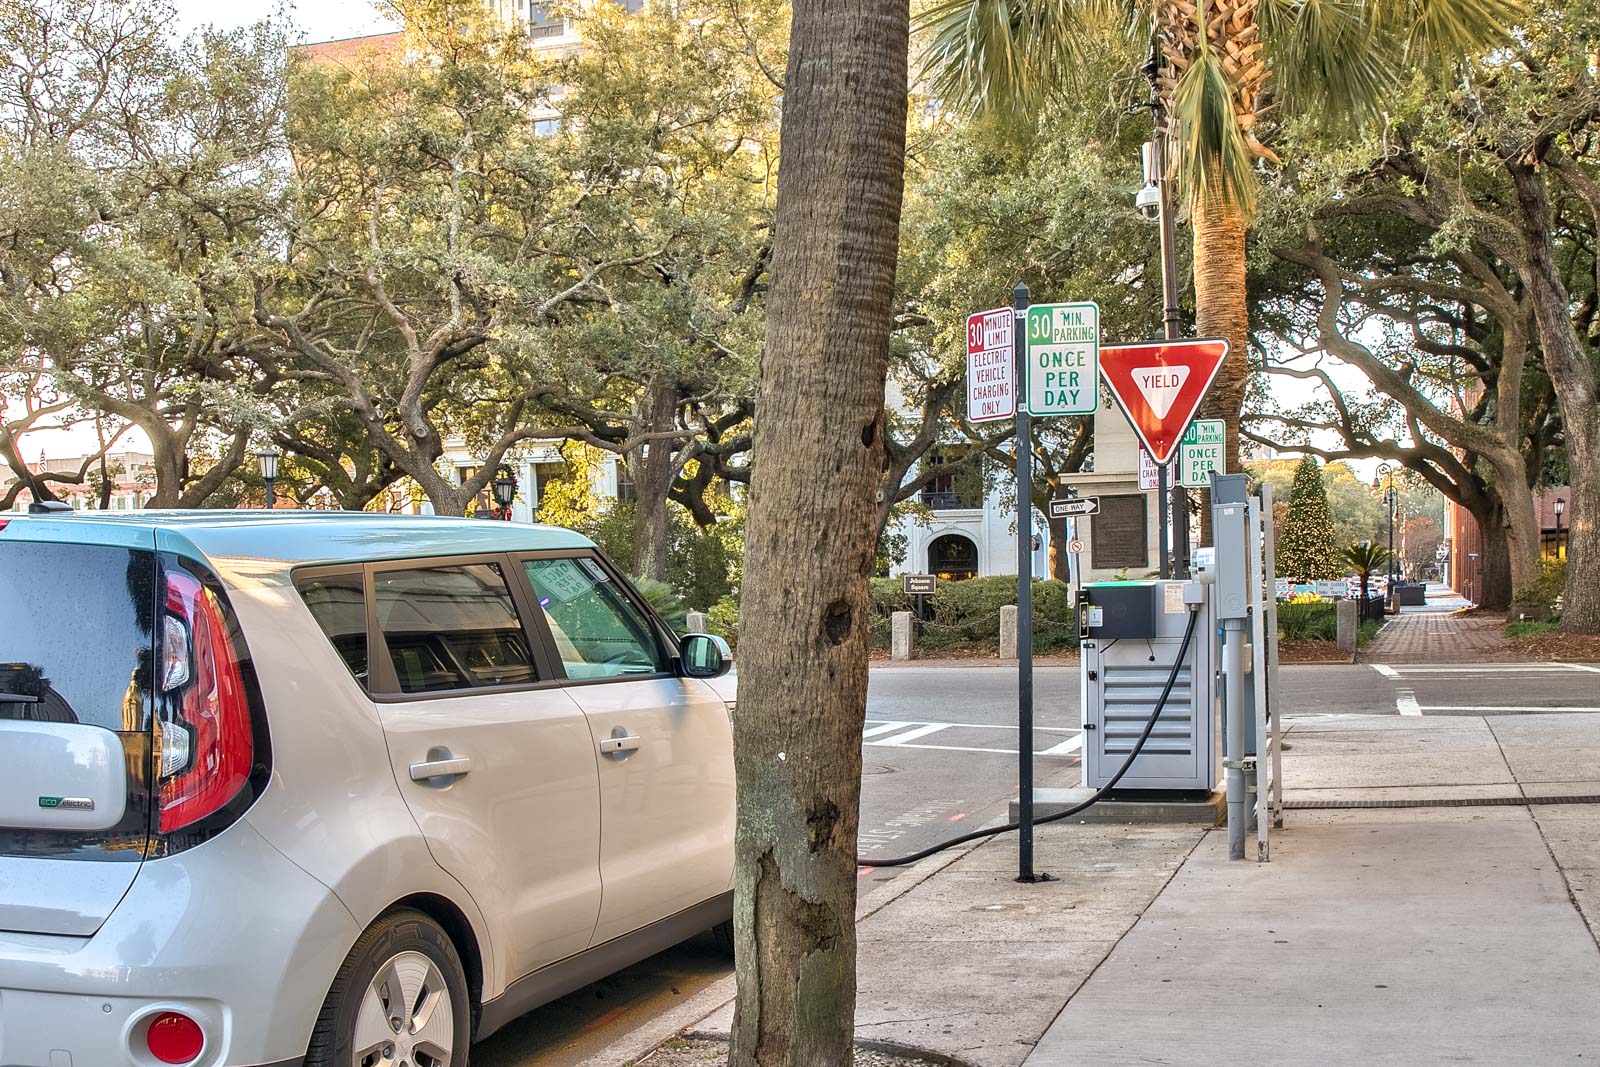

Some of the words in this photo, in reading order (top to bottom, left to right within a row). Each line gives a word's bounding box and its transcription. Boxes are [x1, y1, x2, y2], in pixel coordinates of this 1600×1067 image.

[970, 323, 982, 347] 30
[984, 314, 1011, 331] MINUTE
[1031, 314, 1051, 339] 30
[1062, 311, 1085, 326] MIN.
[988, 330, 1007, 346] LIMIT
[1054, 327, 1094, 341] PARKING
[974, 350, 1007, 367] ELECTRIC
[1040, 351, 1086, 368] ONCE
[976, 367, 1005, 383] VEHICLE
[1046, 371, 1079, 388] PER
[1142, 374, 1180, 389] YIELD
[973, 383, 1009, 400] CHARGING
[1044, 390, 1080, 406] DAY
[981, 400, 1000, 415] ONLY
[1197, 433, 1223, 442] PARKING
[1189, 448, 1218, 459] ONCE
[1192, 461, 1214, 471] PER
[1192, 471, 1207, 482] DA
[1055, 505, 1069, 513] ONE
[1070, 503, 1084, 511] WAY
